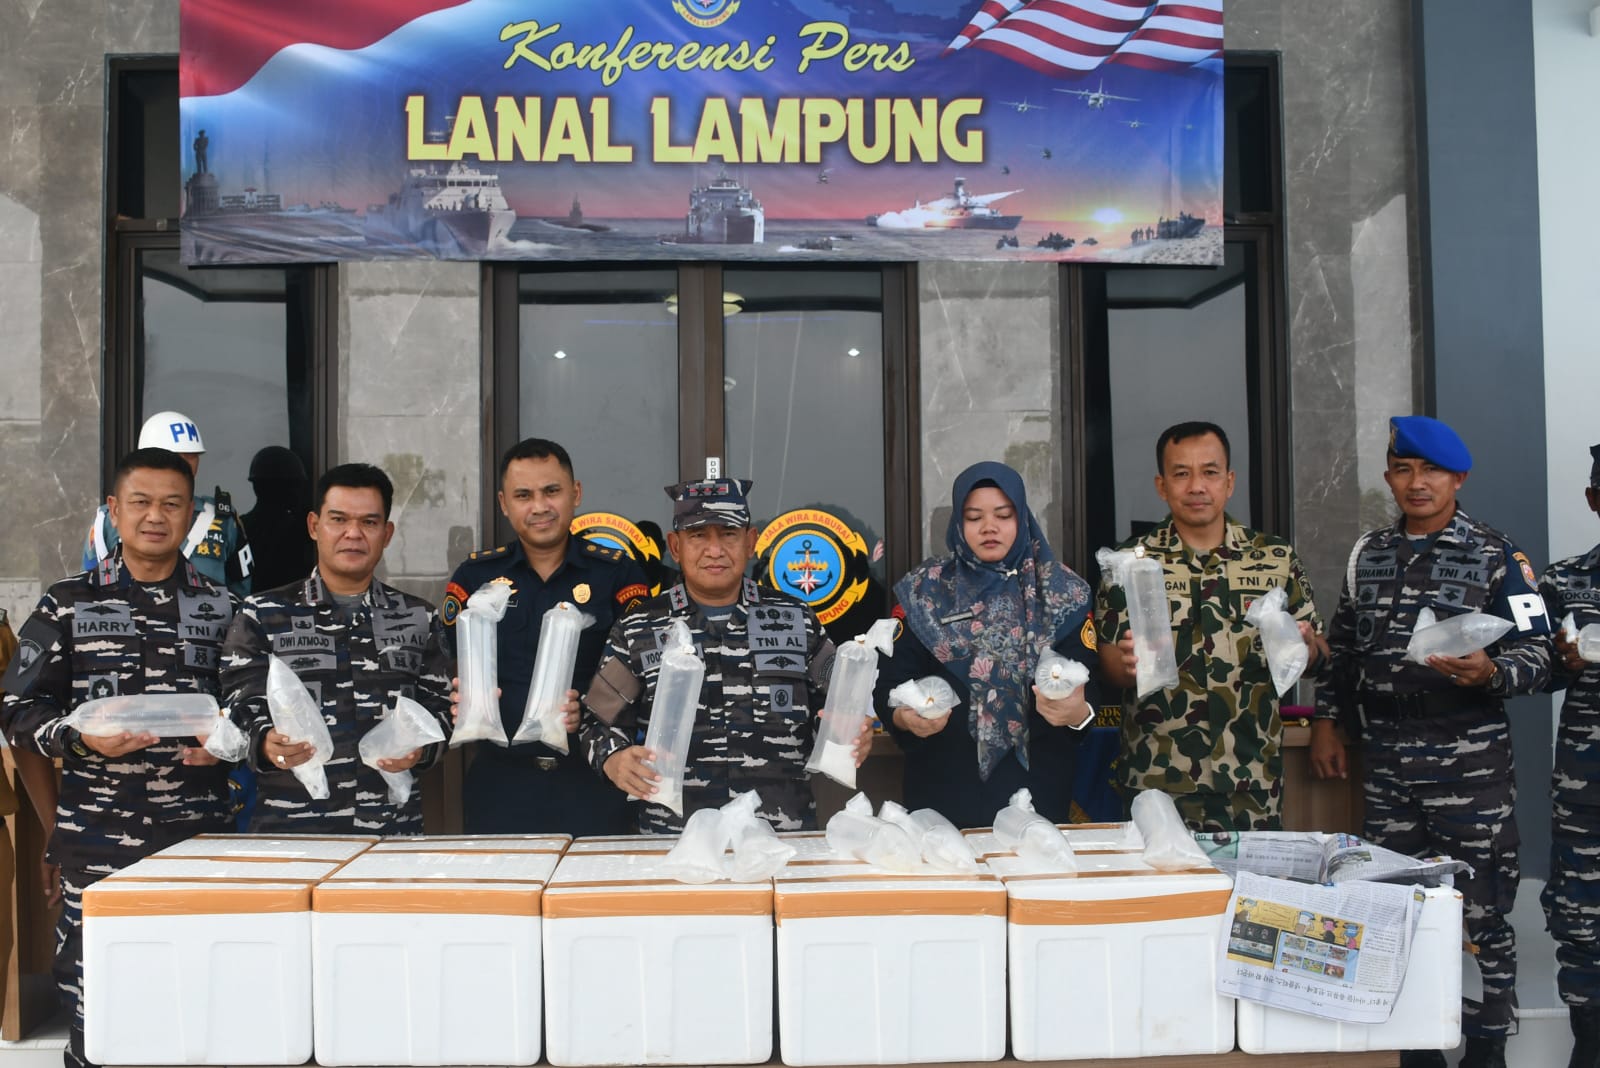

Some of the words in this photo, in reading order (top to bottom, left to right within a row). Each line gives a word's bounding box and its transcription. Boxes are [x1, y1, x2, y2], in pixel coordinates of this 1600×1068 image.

[500, 21, 775, 86] Konferensi
[798, 21, 915, 74] Pers
[405, 95, 633, 163] LANAL
[651, 96, 983, 164] LAMPUNG
[170, 422, 199, 443] PM
[578, 516, 603, 529] WIRA
[605, 516, 643, 543] SABURAI
[764, 521, 784, 541] JALA
[785, 512, 809, 524] WIRA
[813, 513, 851, 540] SABURAI
[238, 543, 255, 578] P
[1237, 576, 1260, 587] TNI
[1438, 567, 1458, 578] TNI
[1464, 570, 1481, 582] AL
[1164, 581, 1187, 591] GAN
[817, 598, 849, 623] PUNG
[1507, 593, 1552, 632] P
[77, 622, 130, 633] HARRY
[184, 624, 211, 637] TNI
[279, 636, 296, 648] DWI
[297, 635, 330, 648] ATMOJO
[381, 636, 406, 647] TNI
[410, 634, 425, 646] AL
[755, 637, 779, 648] TNI
[785, 637, 803, 648] AL
